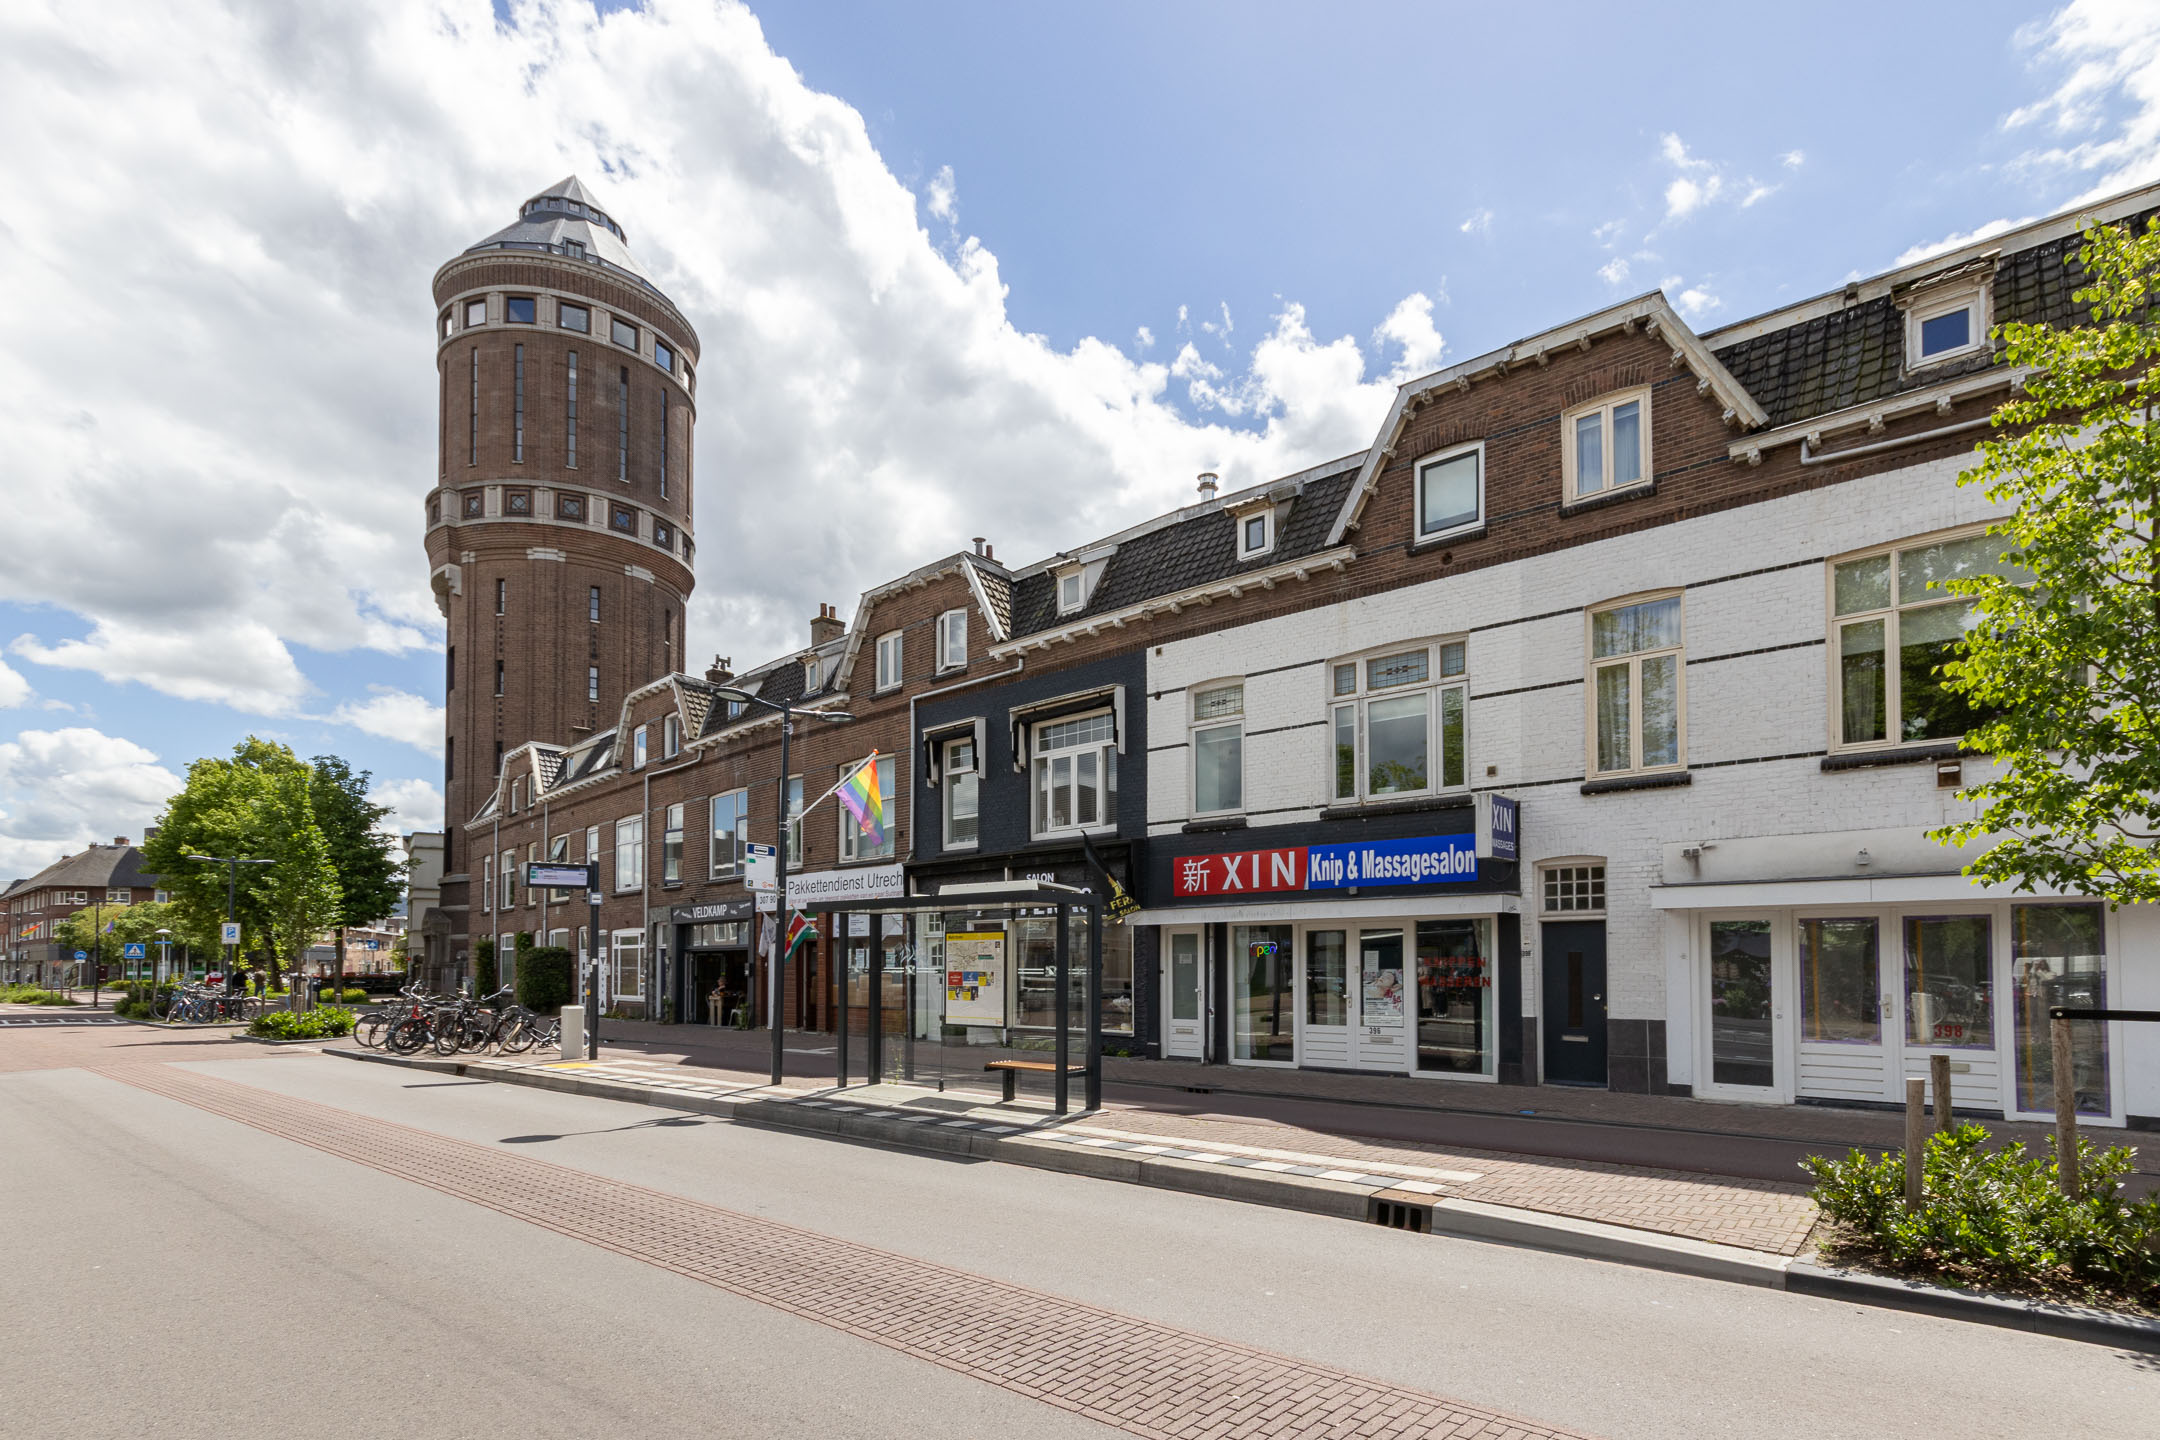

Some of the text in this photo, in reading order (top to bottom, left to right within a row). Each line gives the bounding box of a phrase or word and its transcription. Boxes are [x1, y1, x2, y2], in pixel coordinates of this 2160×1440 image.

[1493, 804, 1512, 833] XIN
[1222, 851, 1296, 890] XIN
[1311, 843, 1475, 886] Knip & Massagesalon
[788, 875, 864, 895] Pakkettendienst
[1026, 872, 1055, 883] SALON
[1183, 858, 1210, 892] 新
[692, 904, 727, 918] VELDKAMP
[1424, 956, 1486, 967] KNIPPEN
[1934, 1024, 1963, 1038] 398
